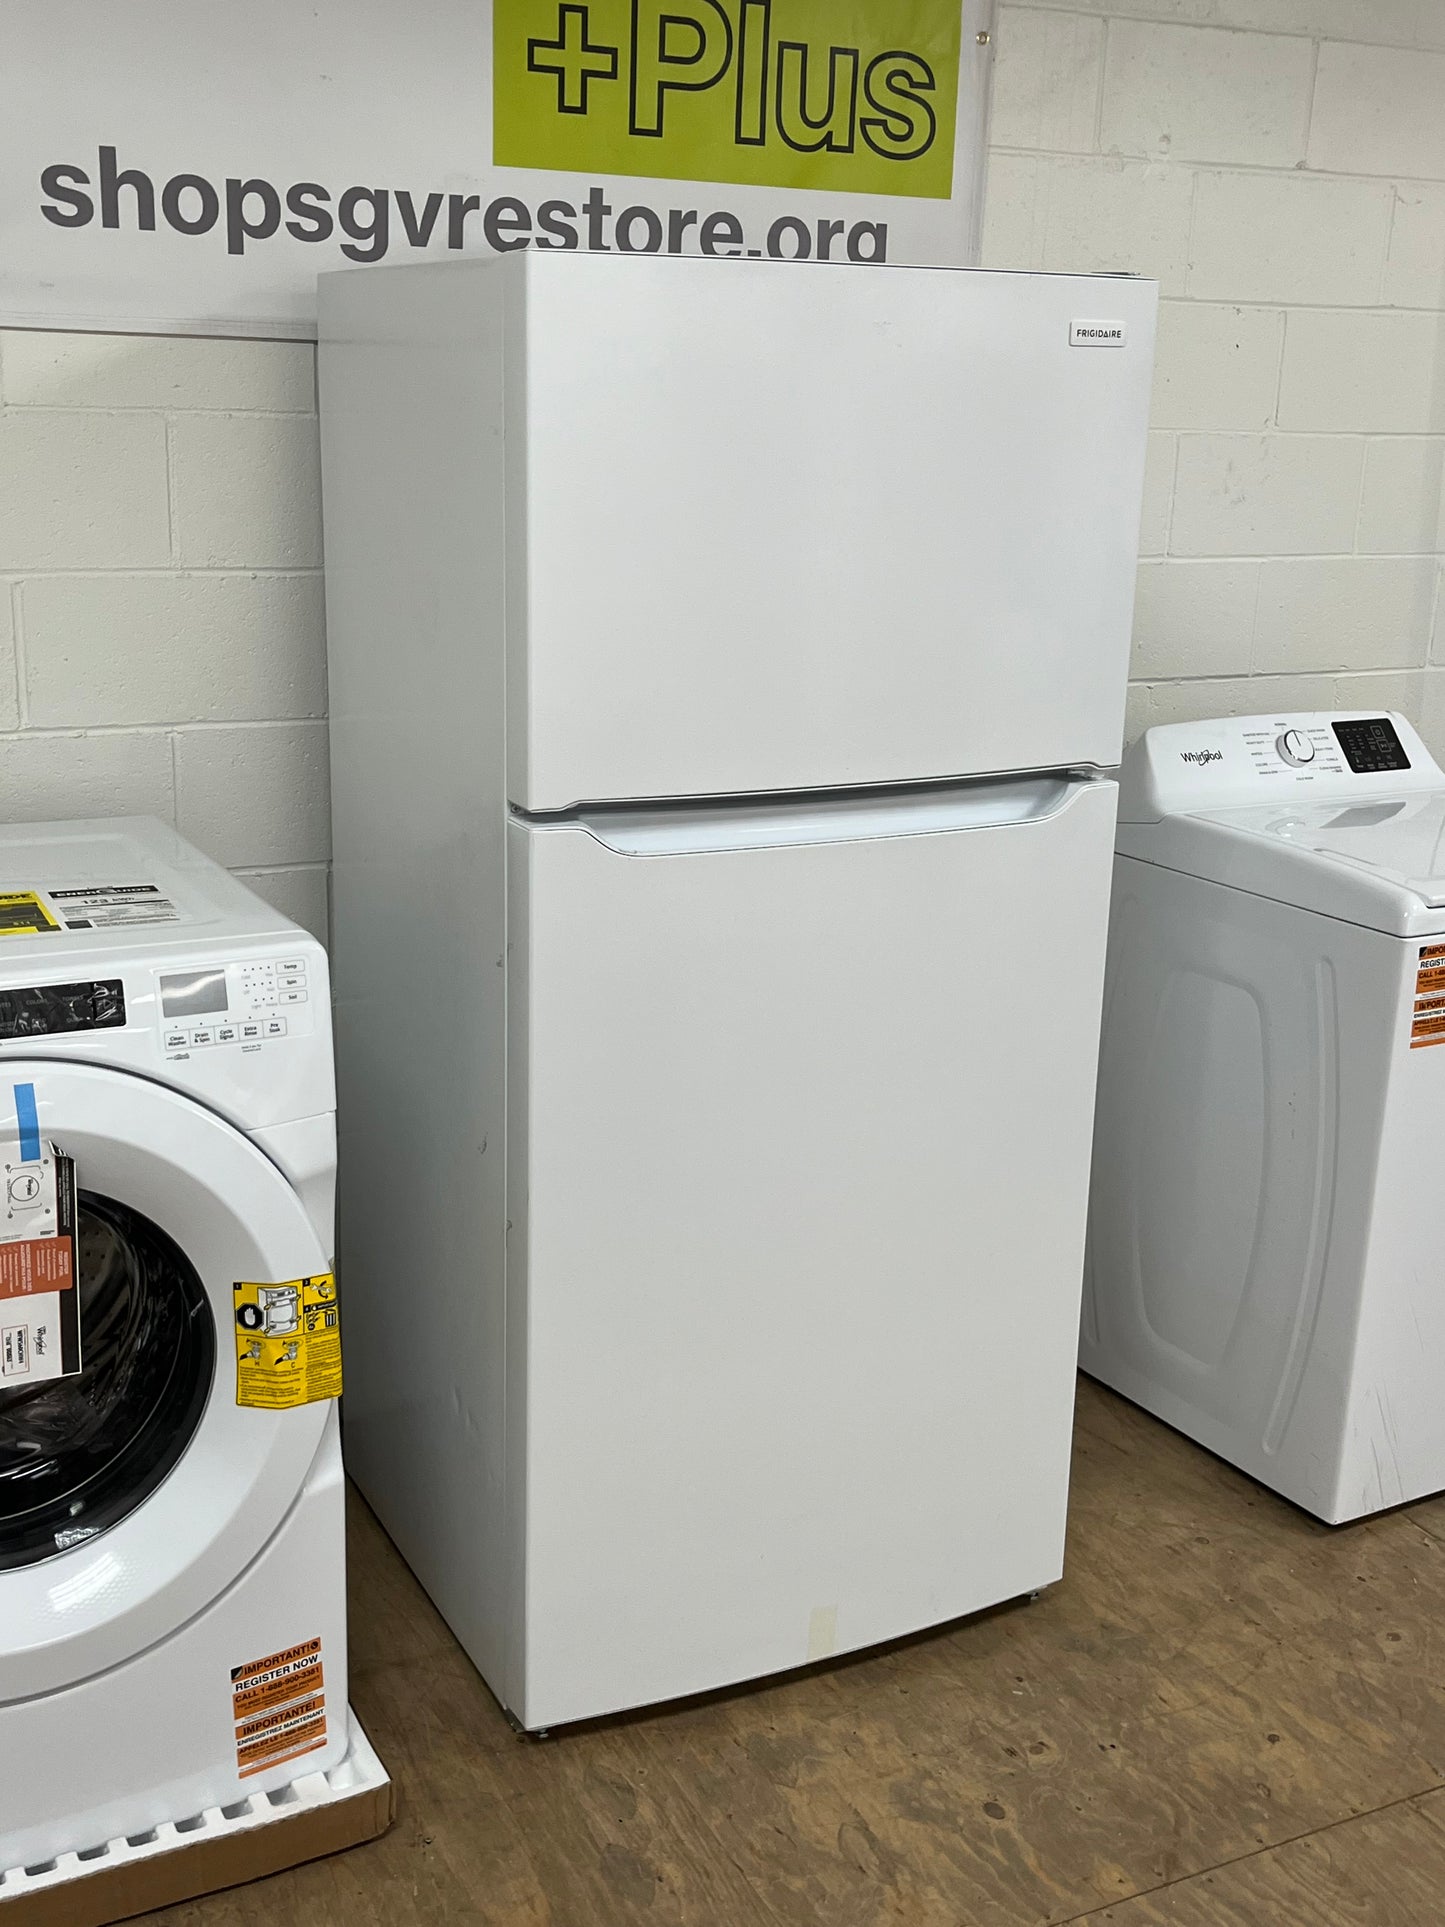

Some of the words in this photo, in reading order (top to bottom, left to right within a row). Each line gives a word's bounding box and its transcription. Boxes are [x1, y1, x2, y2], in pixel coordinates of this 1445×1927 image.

[527, 0, 937, 161] +Plus
[39, 145, 889, 263] shopsgvrestore.org
[1076, 329, 1122, 338] FRIGIDAIRE
[1180, 749, 1223, 766] Whirlpool
[235, 1665, 290, 1692] REGISTER
[293, 1654, 318, 1671] NOW
[244, 1644, 310, 1675] IMPORTANT!
[235, 1690, 259, 1702] CALL
[237, 1725, 282, 1746] ENREGISTREZ
[284, 1708, 324, 1729] MAINTENANT
[243, 1701, 316, 1736] IMPORTANTE!
